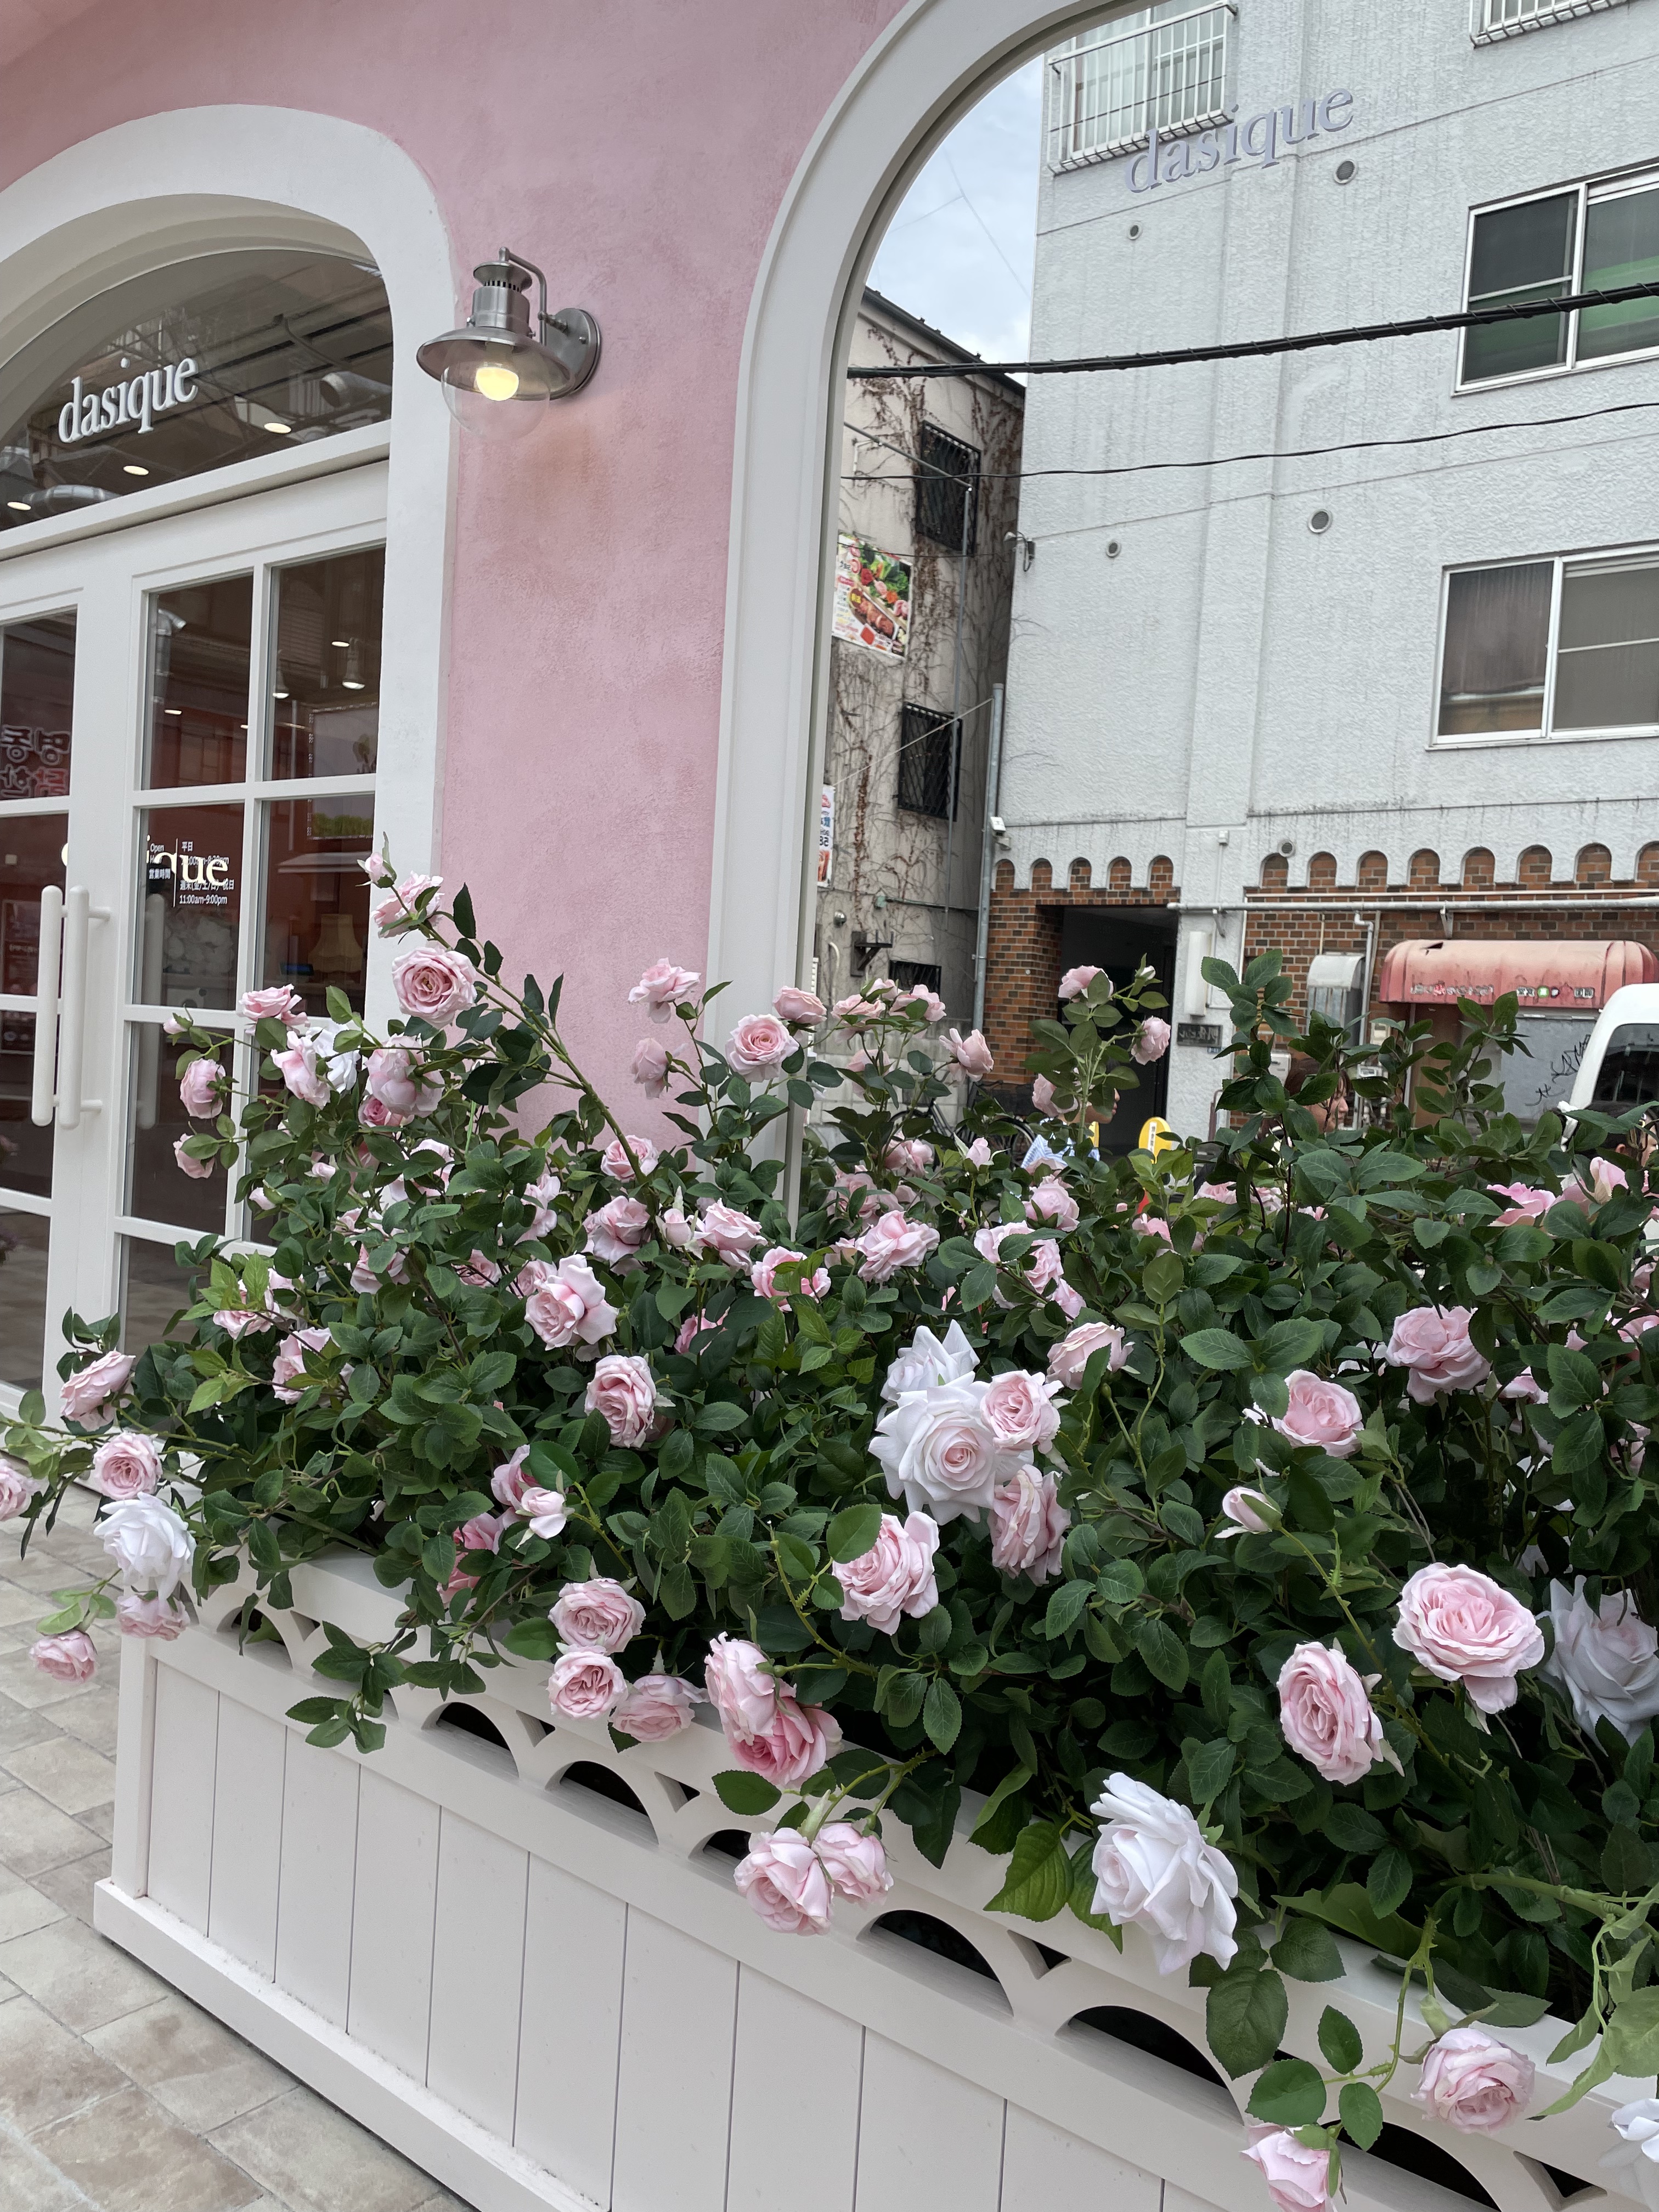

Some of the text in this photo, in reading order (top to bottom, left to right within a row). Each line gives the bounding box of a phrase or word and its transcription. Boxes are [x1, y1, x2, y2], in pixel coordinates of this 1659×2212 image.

[1125, 87, 1355, 193] dasique
[59, 358, 198, 443] dasique
[150, 843, 165, 854] Open
[182, 841, 193, 852] 平日
[150, 854, 163, 864] Hr
[179, 894, 228, 906] 11:00am-9:00pm
